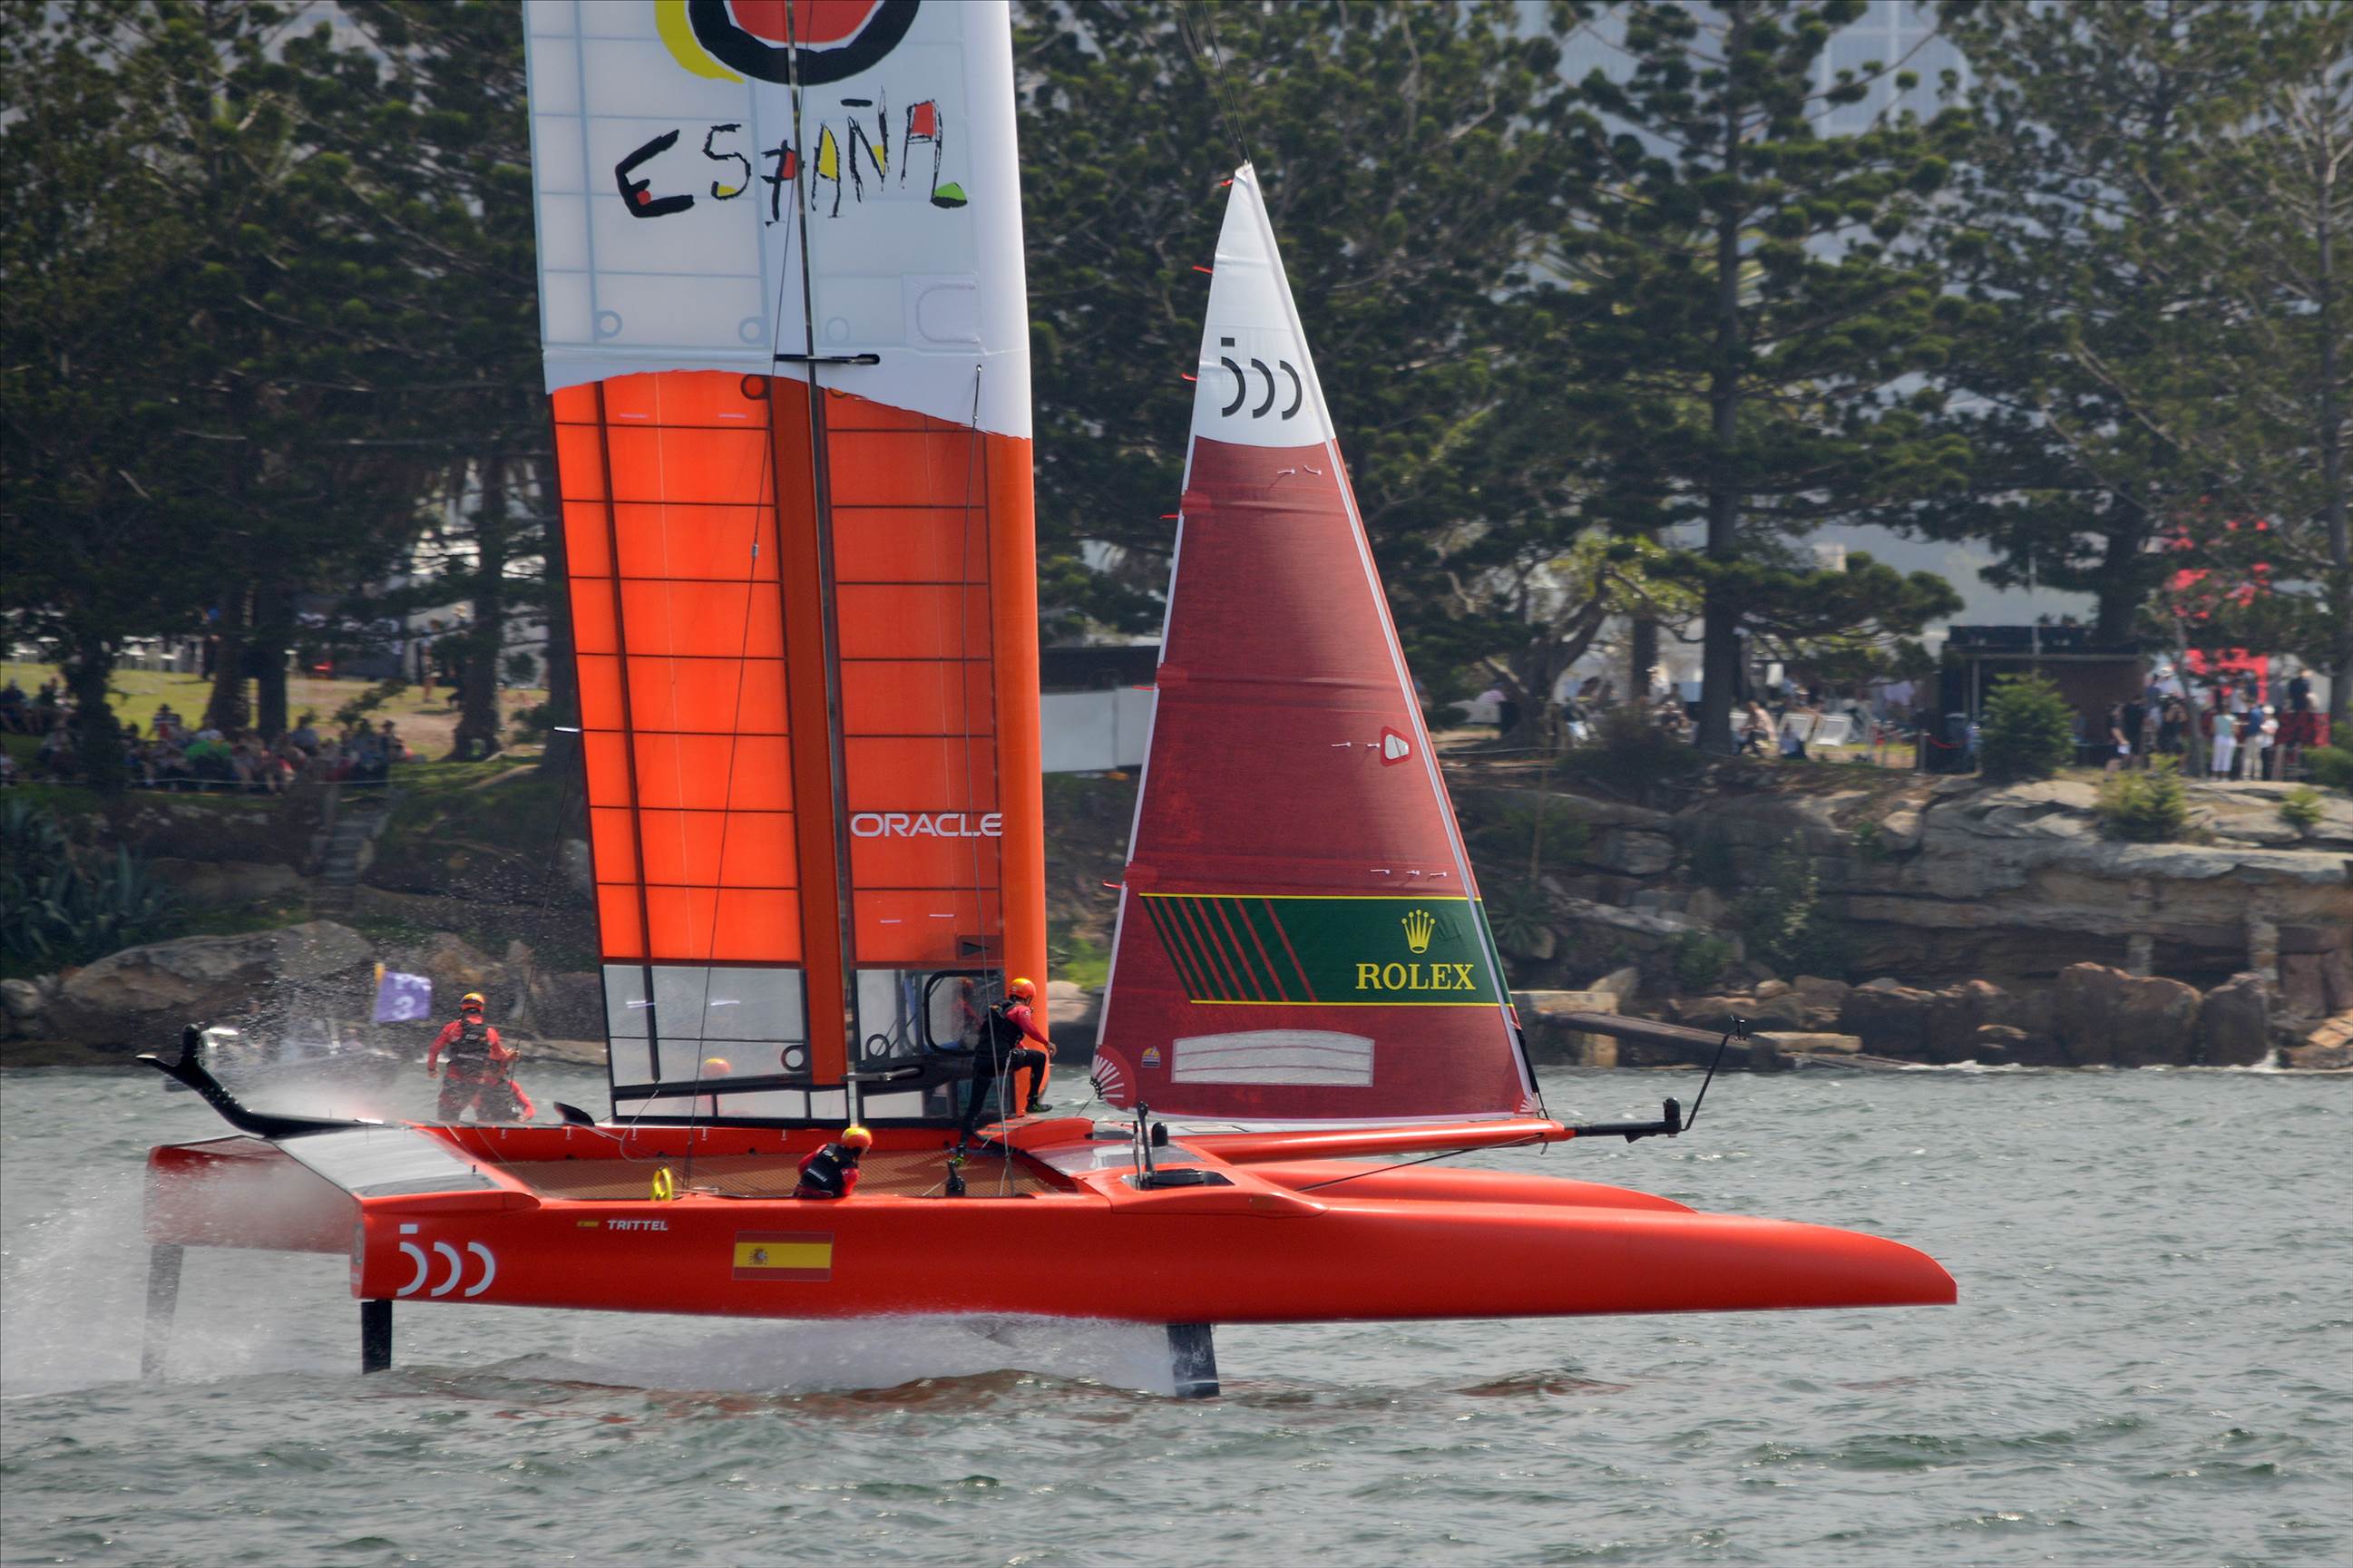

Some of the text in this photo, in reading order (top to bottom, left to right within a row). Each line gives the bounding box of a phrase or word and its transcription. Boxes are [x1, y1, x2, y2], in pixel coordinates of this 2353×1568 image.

[850, 813, 1003, 837] ORACLE
[1355, 962, 1477, 990] ROLEX
[607, 1220, 669, 1232] TRITTEL
